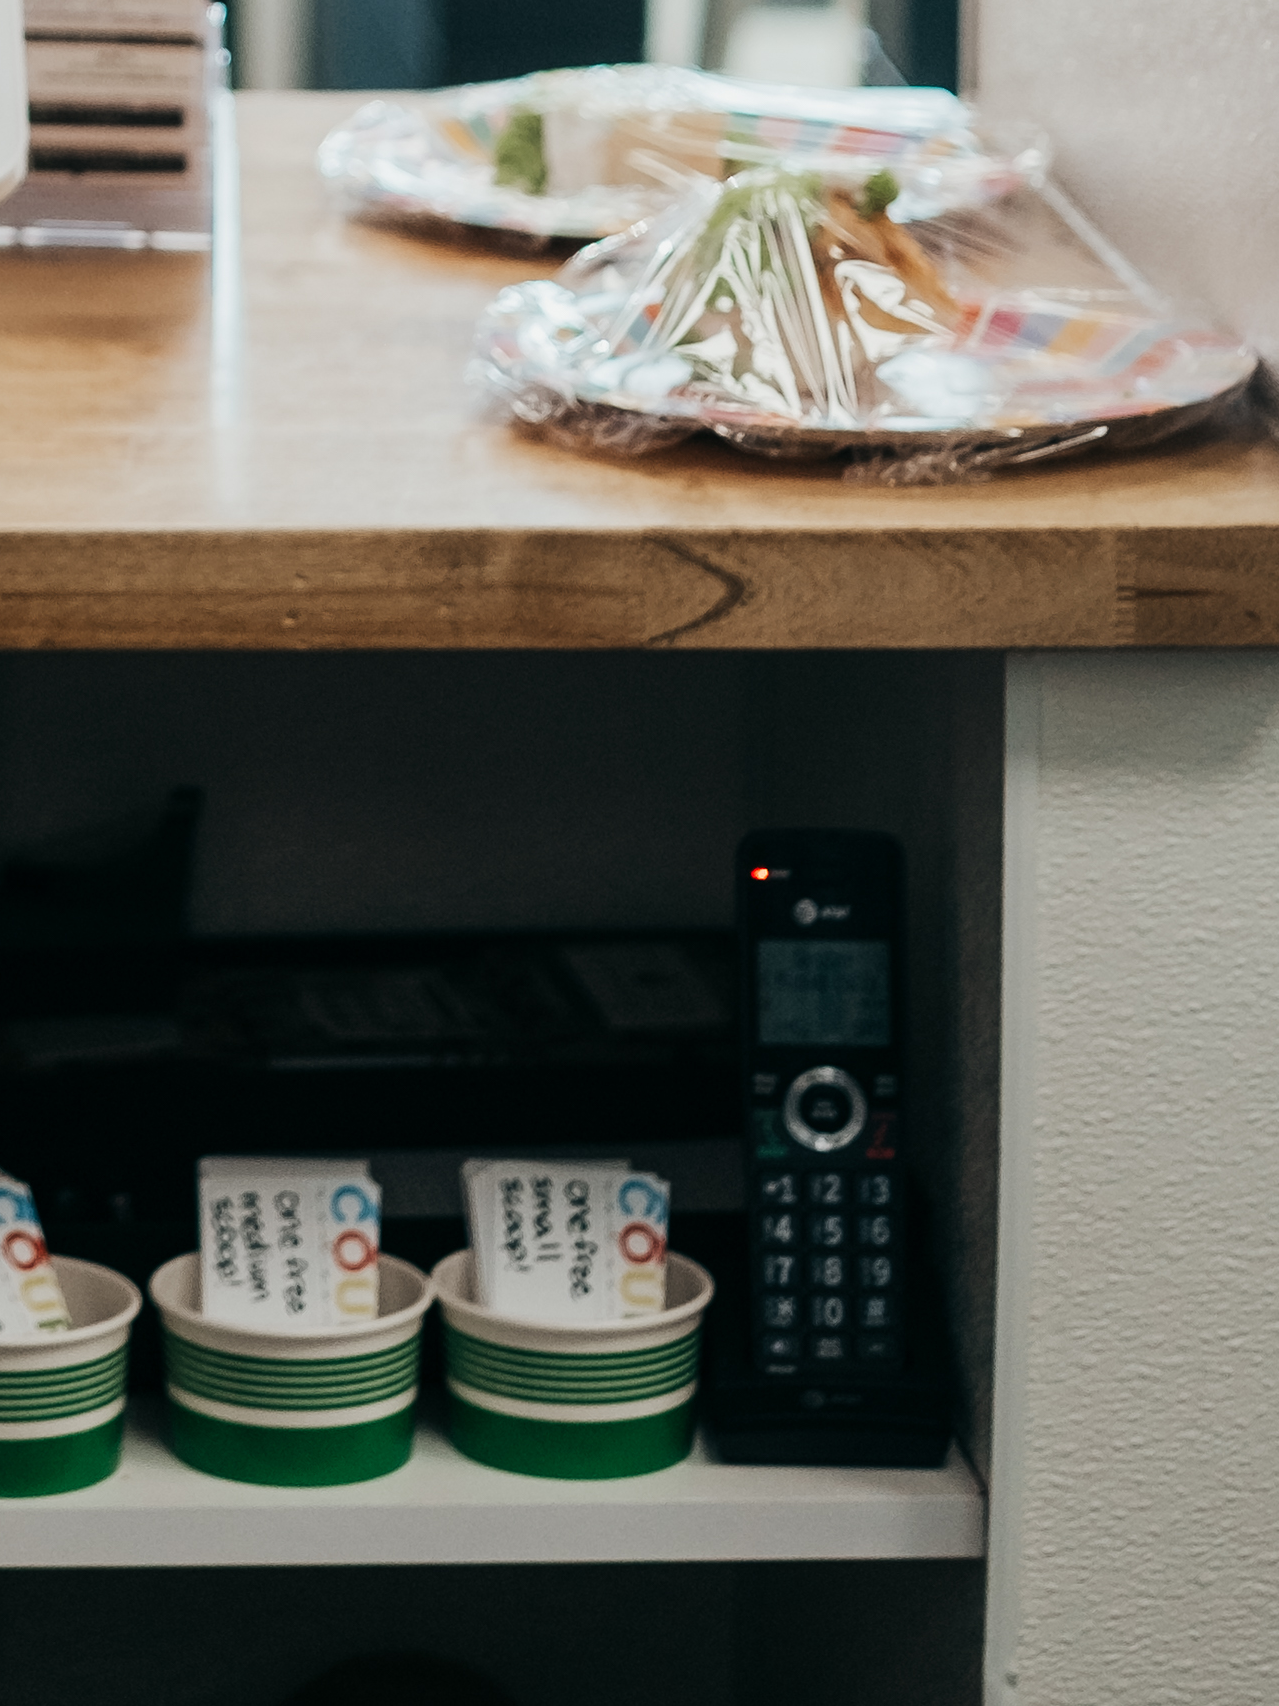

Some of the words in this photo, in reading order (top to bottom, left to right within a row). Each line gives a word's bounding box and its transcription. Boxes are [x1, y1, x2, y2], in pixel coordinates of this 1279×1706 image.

[822, 1173, 843, 1205] 2
[273, 1189, 306, 1250] one
[823, 1214, 843, 1246] 5
[822, 1255, 843, 1287] 8
